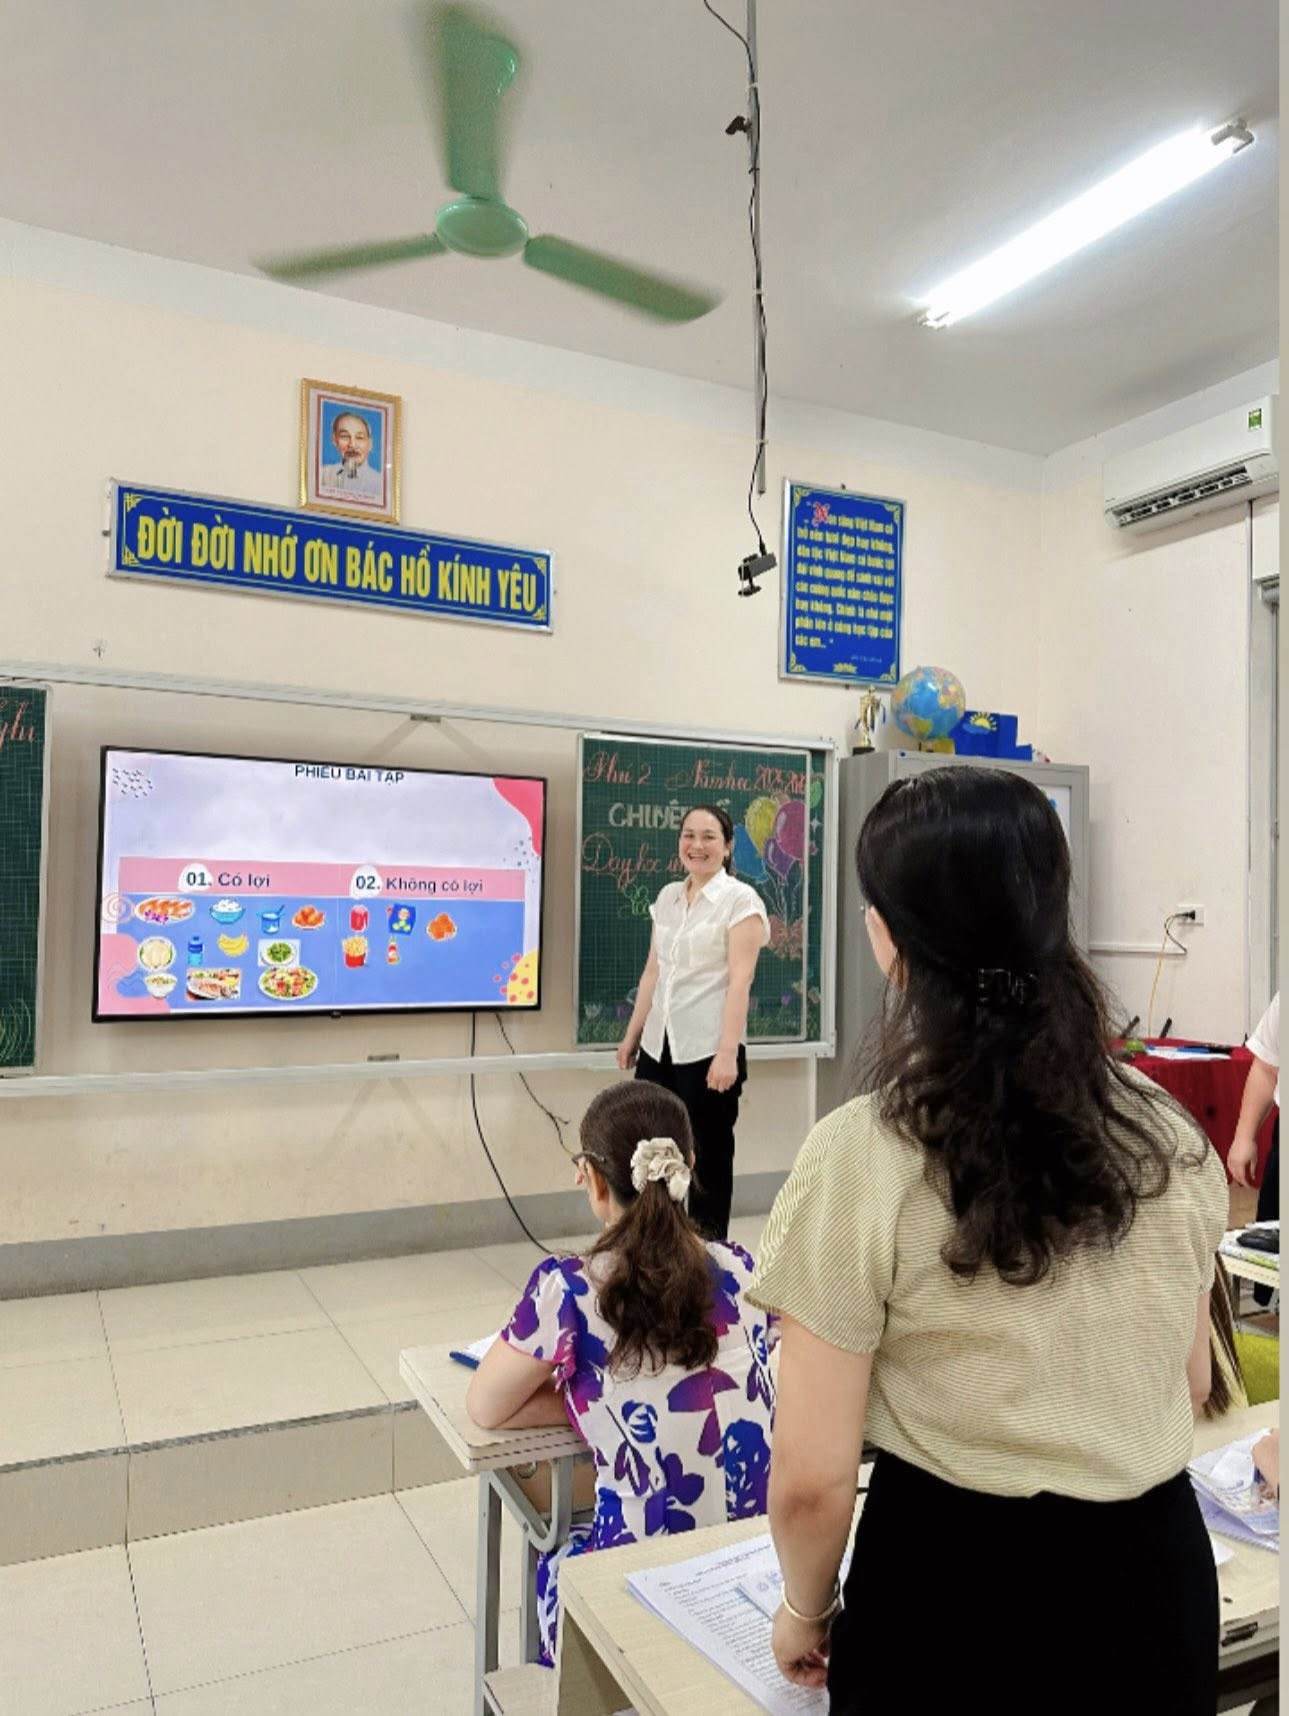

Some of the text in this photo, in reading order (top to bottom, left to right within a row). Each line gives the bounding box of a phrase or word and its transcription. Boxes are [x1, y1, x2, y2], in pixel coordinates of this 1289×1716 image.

[137, 506, 537, 612] ĐỜI ĐỜI NHỚ ƠN BÁC HỒ KÍNH YÊU
[186, 871, 270, 888] 01. Có lợi
[356, 875, 381, 890] 02.
[386, 877, 436, 894] Không
[464, 879, 483, 894] lợi
